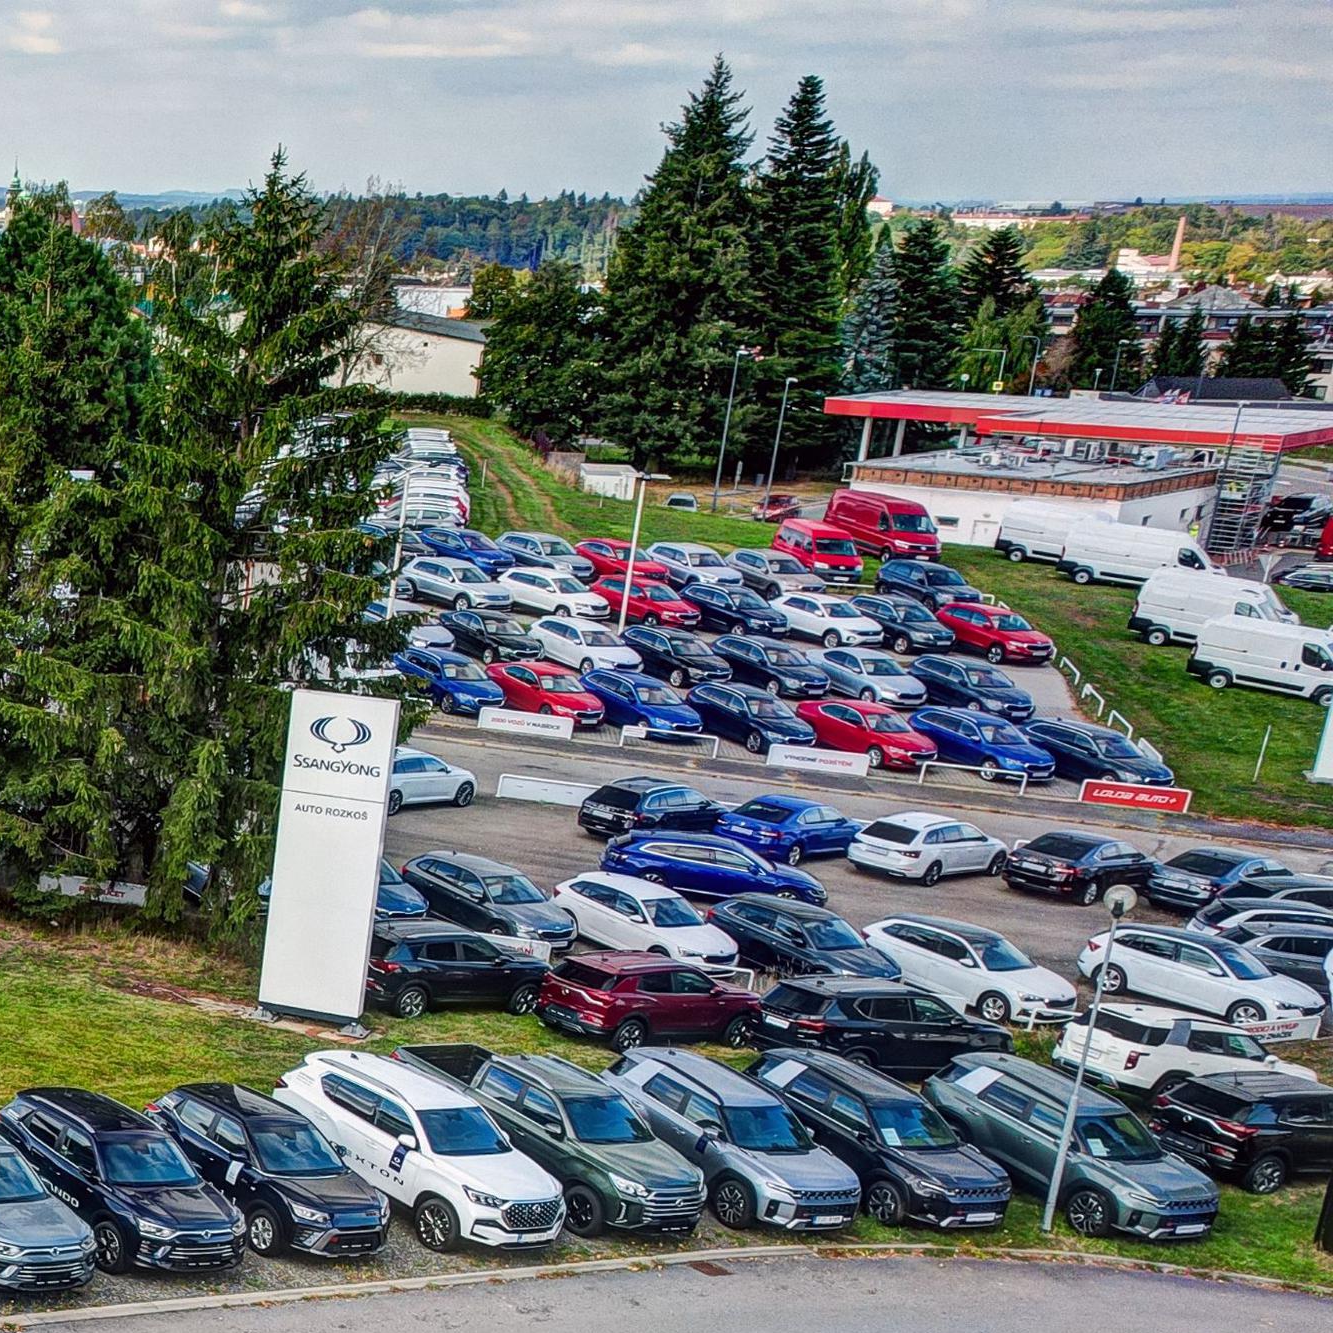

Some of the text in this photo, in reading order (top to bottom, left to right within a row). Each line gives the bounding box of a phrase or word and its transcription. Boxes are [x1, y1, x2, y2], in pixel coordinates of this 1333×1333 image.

[293, 754, 380, 778] SSANGYONG
[295, 803, 368, 821] AUTO ROZKOŠ
